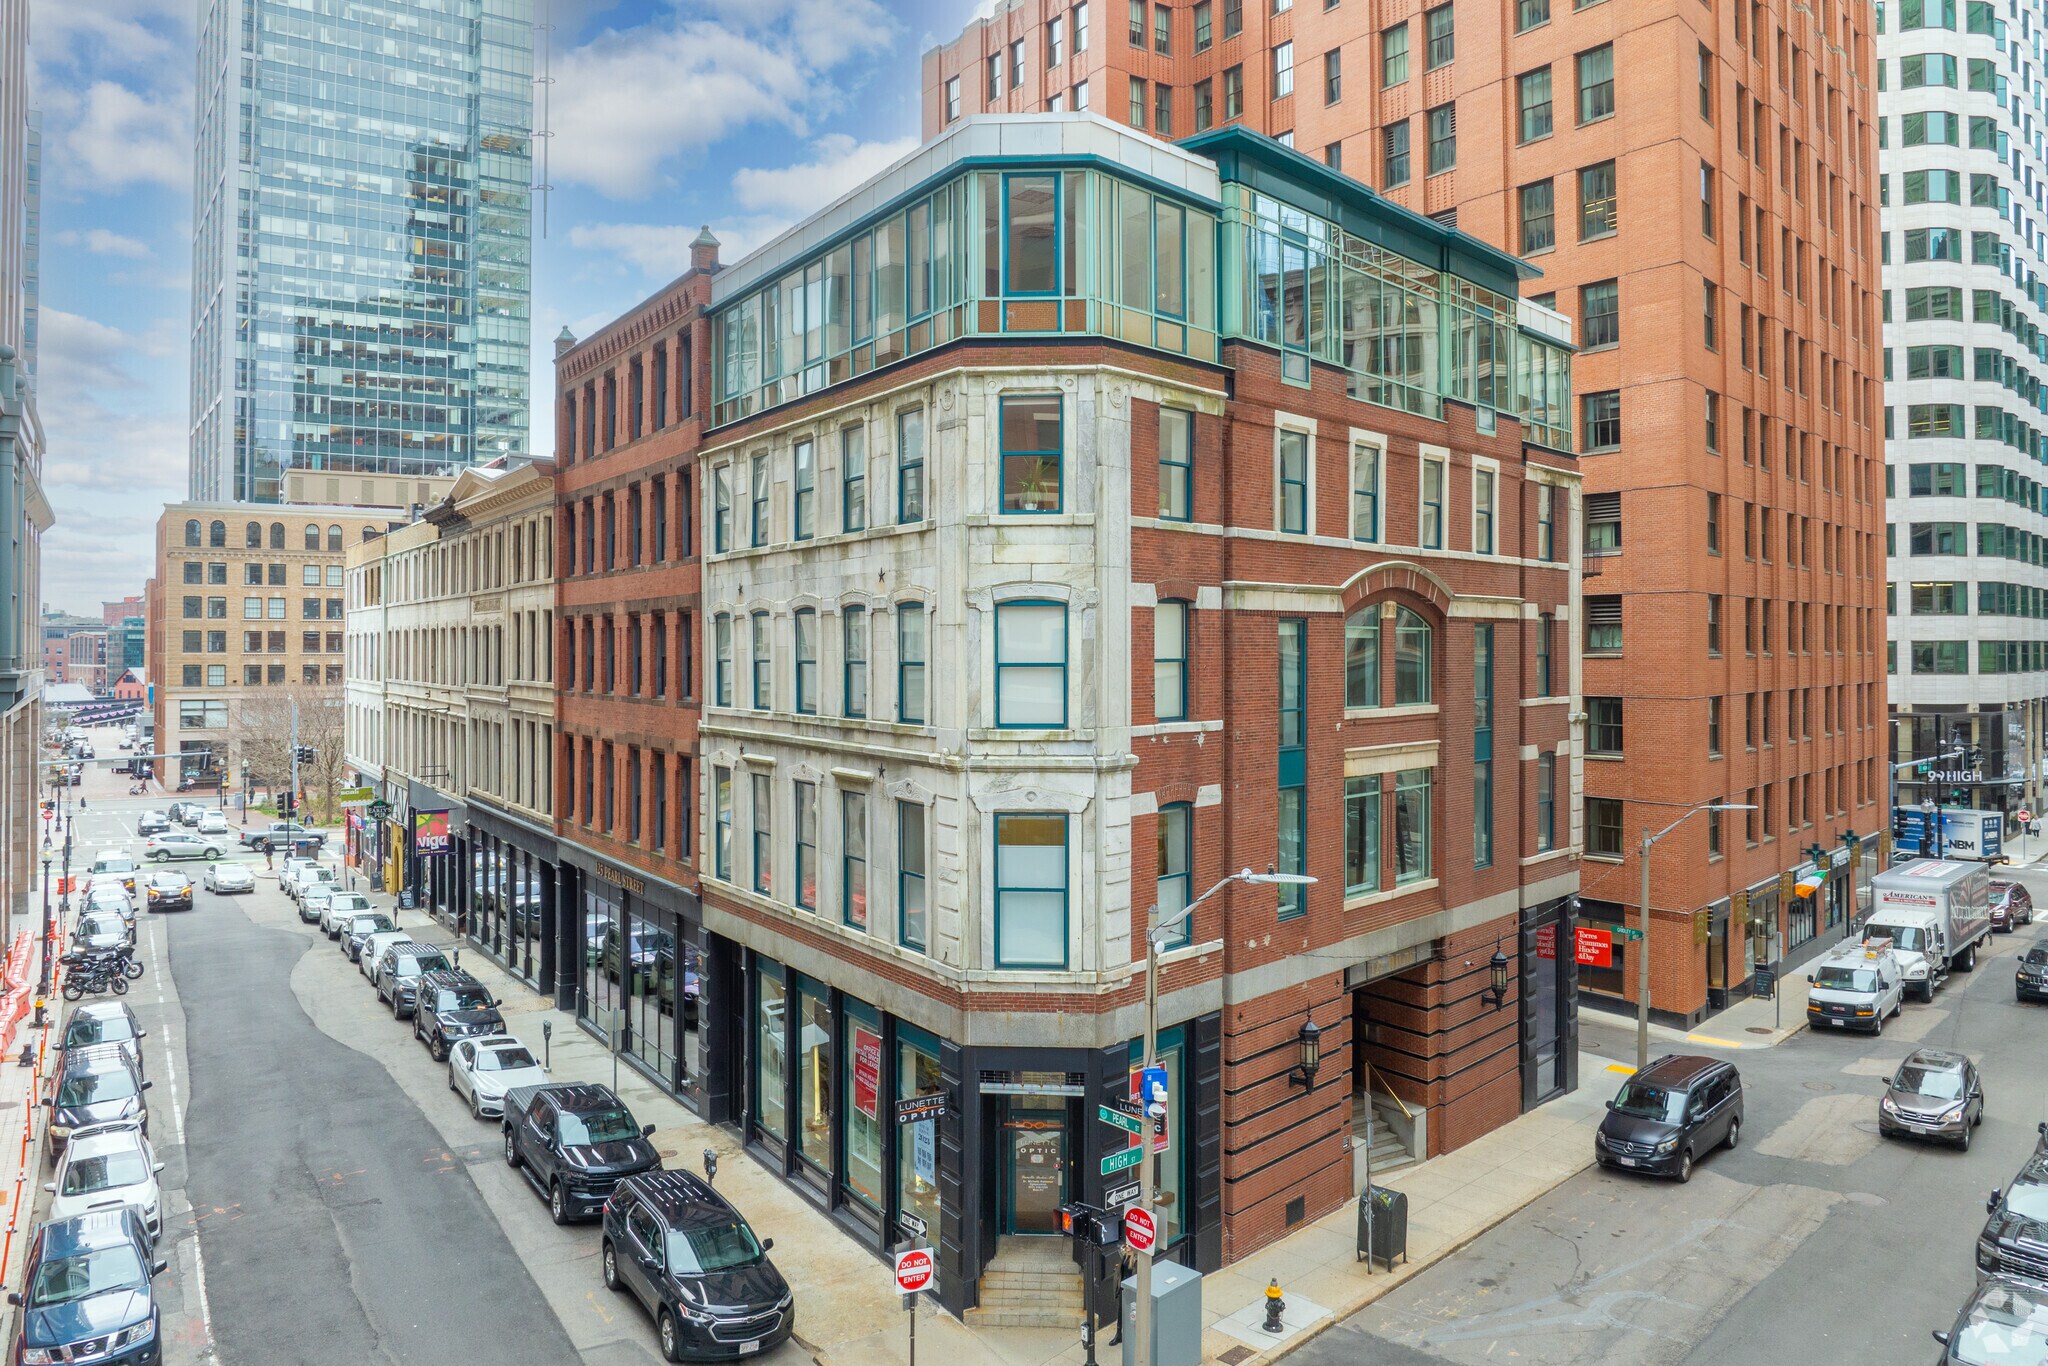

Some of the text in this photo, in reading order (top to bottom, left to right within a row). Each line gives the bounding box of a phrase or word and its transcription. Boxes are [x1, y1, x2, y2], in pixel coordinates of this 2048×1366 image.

[1927, 770, 1983, 782] 99 HIGH
[417, 832, 448, 850] viga
[1948, 839, 1975, 851] NBM
[604, 866, 622, 885] PEARL
[622, 874, 645, 895] STREET
[1887, 891, 1929, 900] AMERICAN
[1578, 930, 1598, 940] Torres
[1578, 939, 1608, 949] Scammon
[1578, 945, 1599, 954] Hincks
[1577, 953, 1594, 963] &Day
[859, 1056, 868, 1064] FOR
[899, 1096, 945, 1112] LUNETTE
[1119, 1103, 1142, 1115] LUNE
[899, 1107, 946, 1123] OPTIC
[1112, 1113, 1129, 1128] PEARL
[1109, 1153, 1136, 1171] HIGH ST
[1114, 1187, 1138, 1201] ONE WAY
[1129, 1212, 1151, 1228] DO NOT
[1129, 1230, 1148, 1244] ENTER
[901, 1257, 928, 1269] DO NOT
[903, 1273, 926, 1284] ENTER
